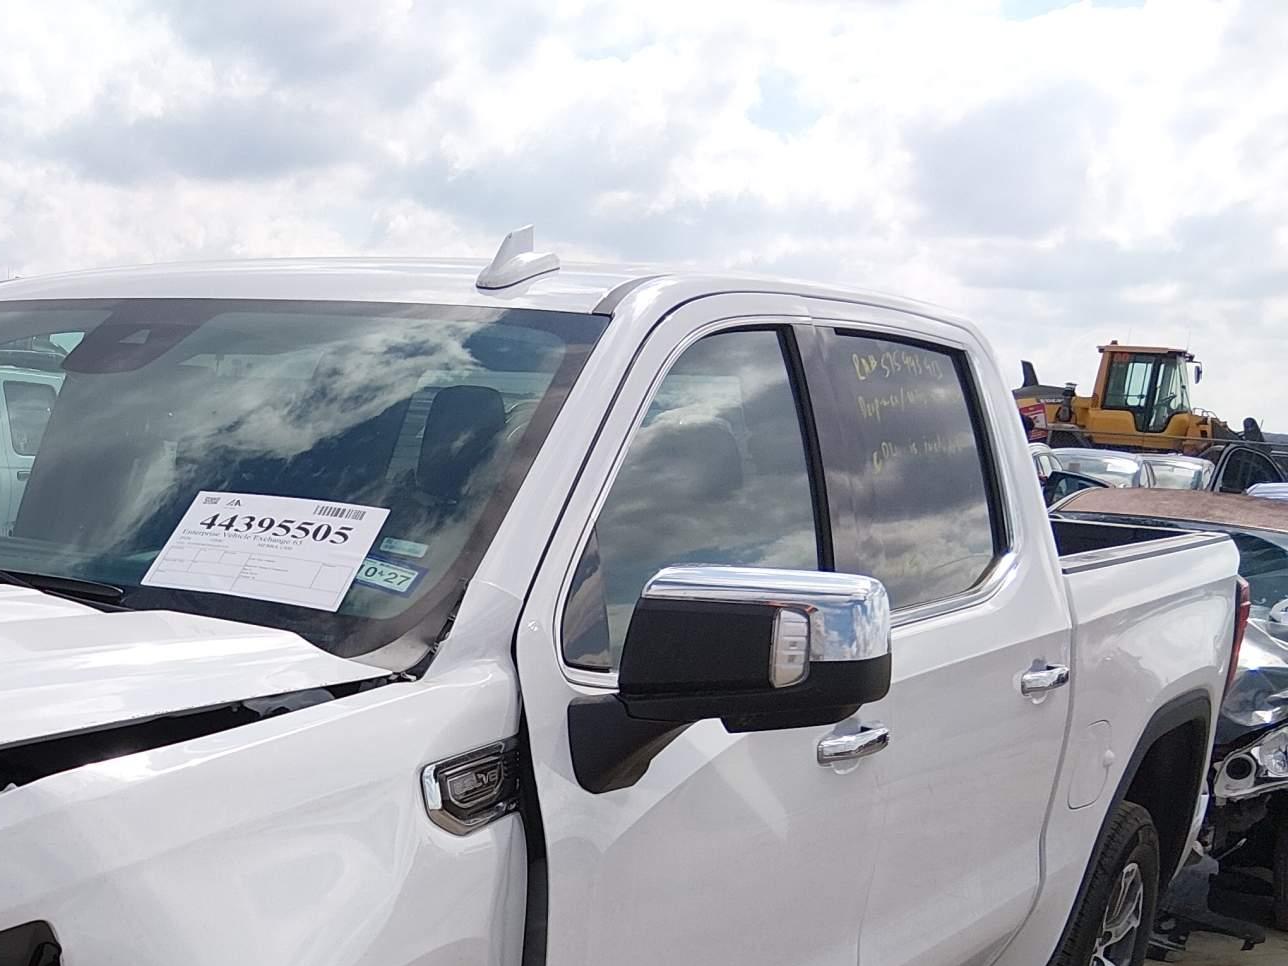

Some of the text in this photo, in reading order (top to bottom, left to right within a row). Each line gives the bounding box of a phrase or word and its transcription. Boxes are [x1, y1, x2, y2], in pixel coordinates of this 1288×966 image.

[182, 528, 221, 538] Enterprise
[223, 531, 252, 541] Vehicle
[253, 534, 294, 546] Exchange
[200, 513, 355, 545] 44395505
[383, 571, 412, 587] 27
